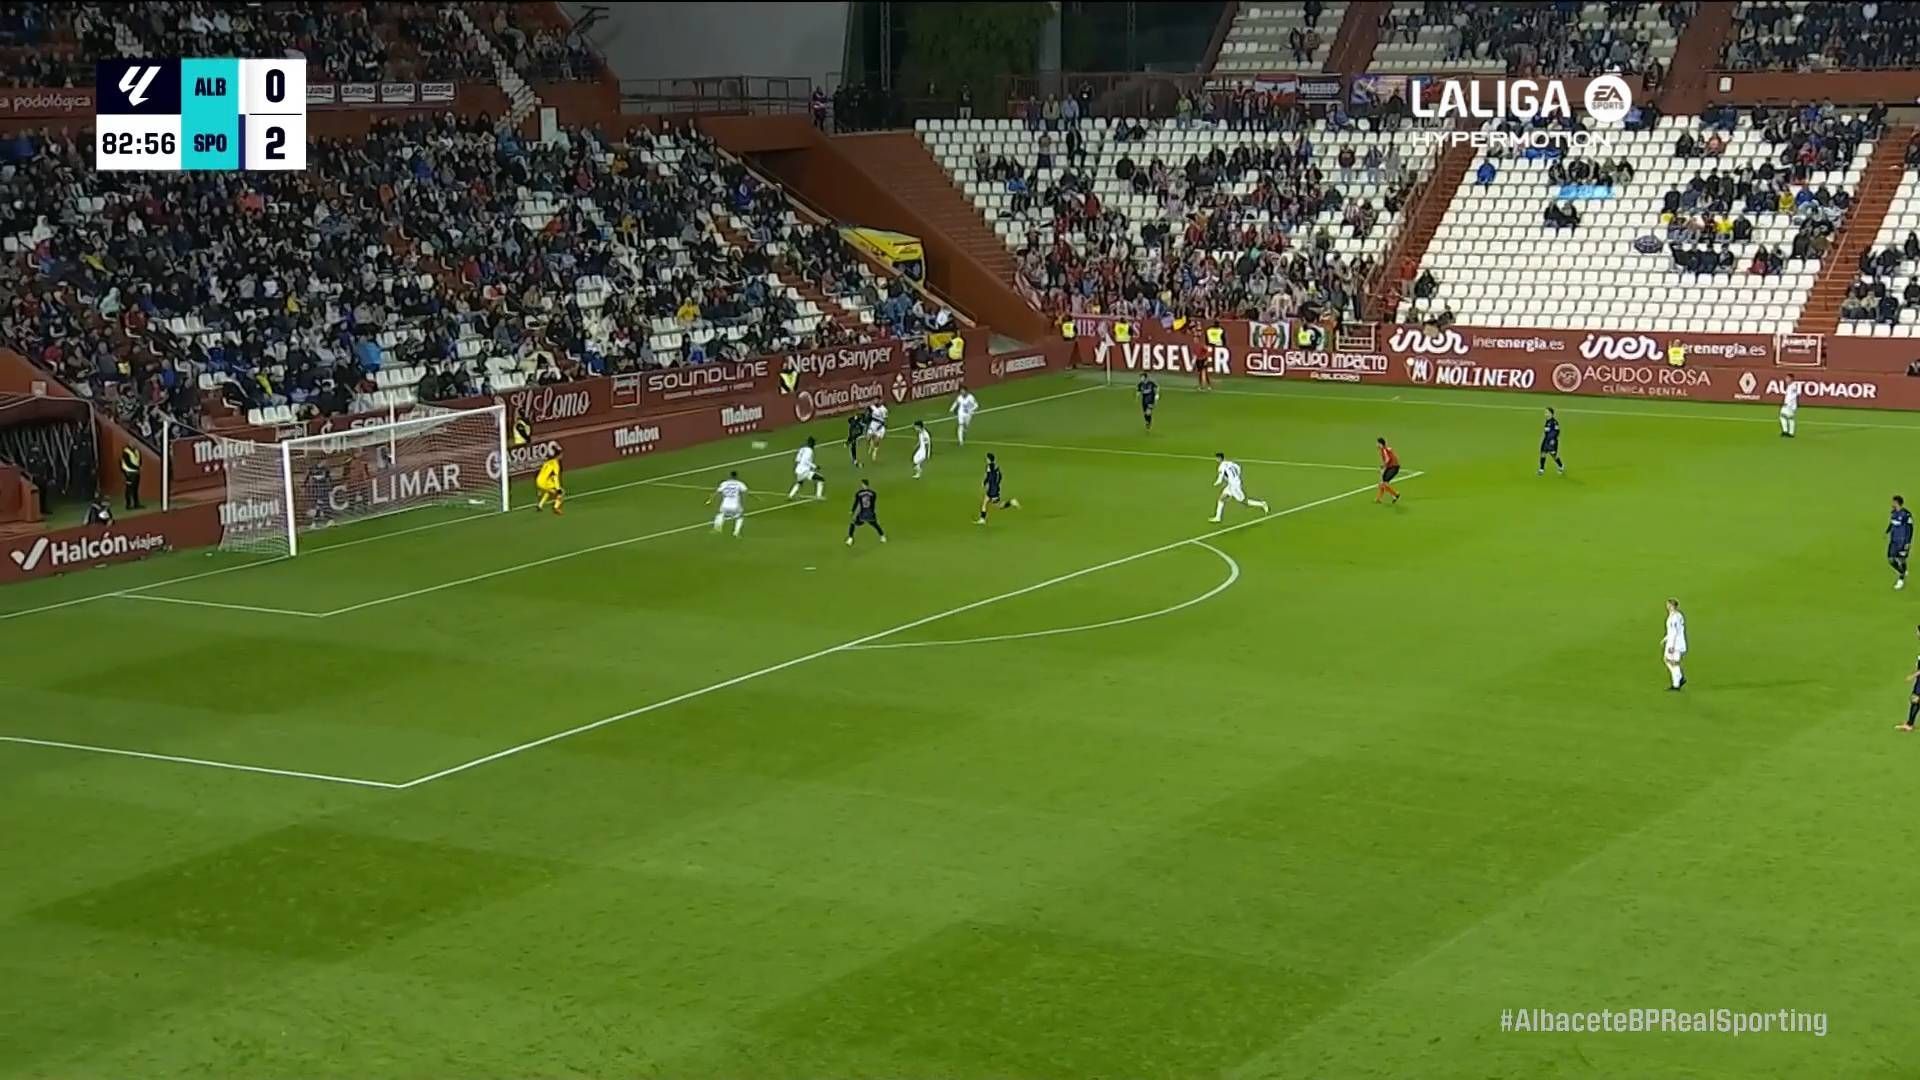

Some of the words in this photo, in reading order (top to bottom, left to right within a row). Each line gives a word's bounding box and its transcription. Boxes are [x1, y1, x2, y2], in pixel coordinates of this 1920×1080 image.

[838, 346, 893, 371] Sanyper
[1436, 367, 1534, 388] MOLINERO
[1583, 364, 1652, 383] AGUDO
[1658, 368, 1711, 386] ROSA
[1649, 387, 1688, 396] DENTAL
[533, 387, 592, 422] Lomo
[372, 464, 462, 504] LIMAR
[51, 532, 128, 566] Halcón
[129, 533, 164, 551] viajes
